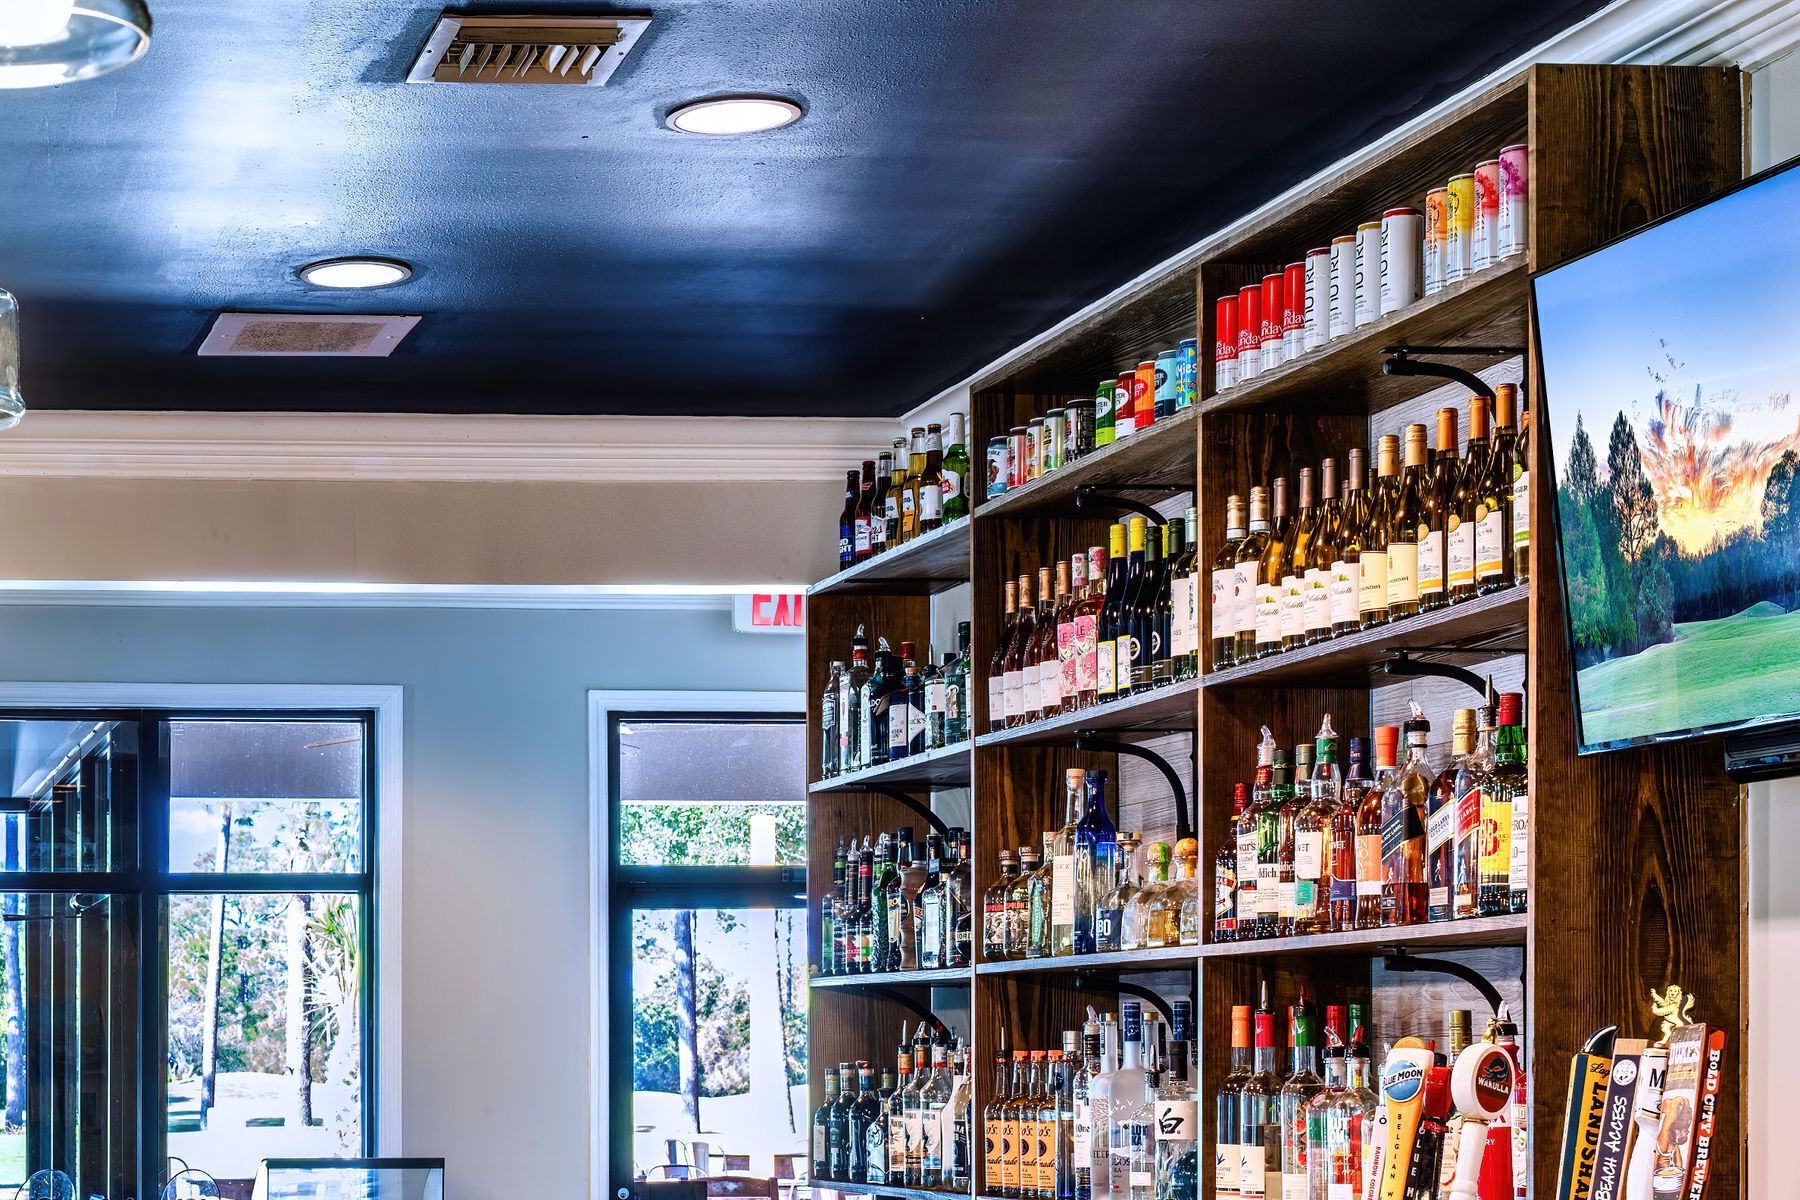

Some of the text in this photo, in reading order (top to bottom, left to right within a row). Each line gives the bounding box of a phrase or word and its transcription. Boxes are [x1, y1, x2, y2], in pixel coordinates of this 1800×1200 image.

[752, 594, 803, 627] EXI
[1383, 1069, 1423, 1089] BLUE MOON
[1478, 1076, 1510, 1095] WAKULLA
[1705, 1049, 1721, 1091] BOLD
[1604, 1095, 1627, 1152] ACCESS
[1701, 1093, 1715, 1134] CITY
[1373, 1146, 1382, 1177] RAINBOW
[1390, 1113, 1402, 1180] BELGIAN
